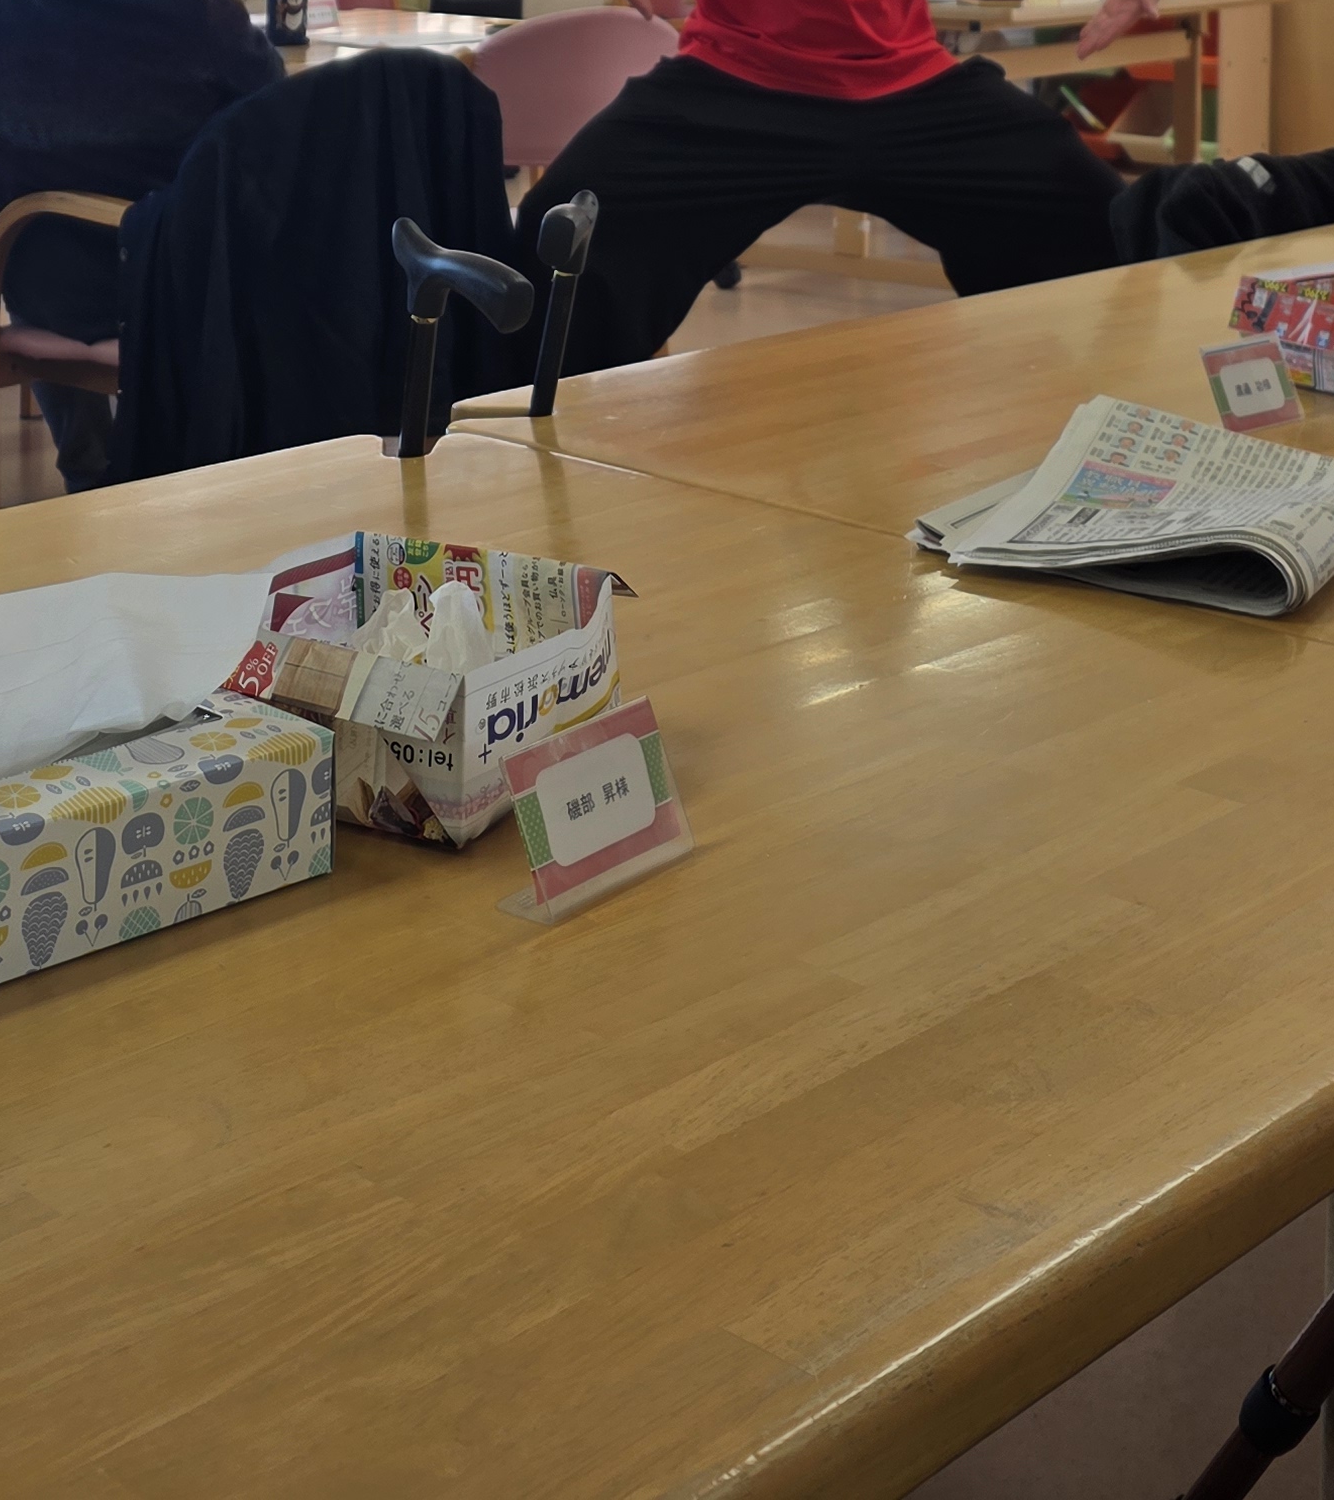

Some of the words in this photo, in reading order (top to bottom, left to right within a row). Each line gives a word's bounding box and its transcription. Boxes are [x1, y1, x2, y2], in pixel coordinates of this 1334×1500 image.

[255, 643, 278, 676] OFF
[389, 689, 415, 731] 選べる
[383, 737, 454, 772] tel:05
[566, 792, 595, 821] 磯部
